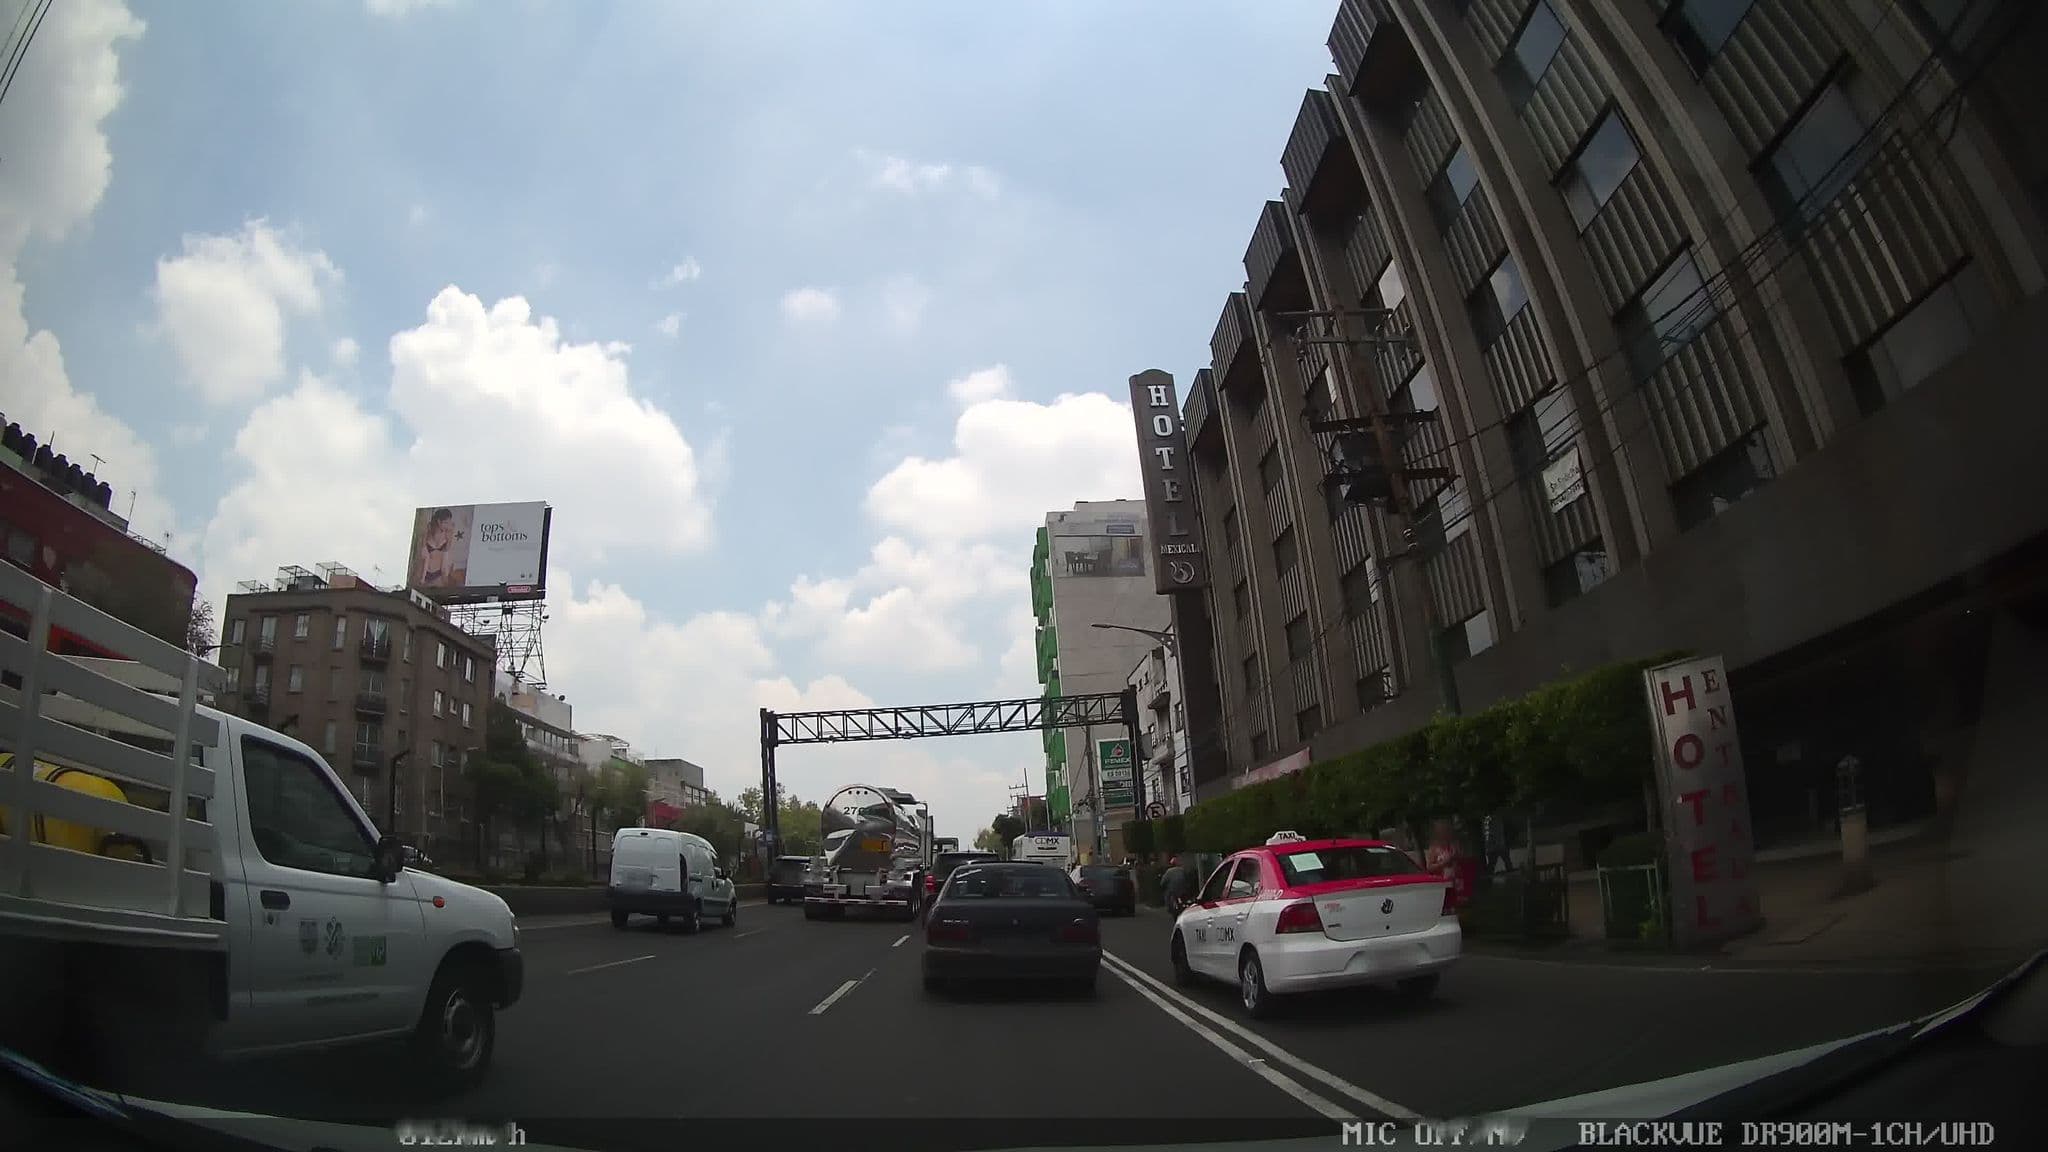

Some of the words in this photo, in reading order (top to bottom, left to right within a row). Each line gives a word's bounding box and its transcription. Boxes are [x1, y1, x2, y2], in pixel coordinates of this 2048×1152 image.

[1147, 385, 1189, 536] HOTEL
[480, 522, 505, 535] tops
[481, 531, 528, 542] bottoms
[1660, 674, 1722, 931] HOTEL
[1034, 837, 1060, 845] CDMX
[1278, 832, 1296, 841] TAXI
[1194, 927, 1207, 943] TAXI
[1216, 926, 1236, 943] CDMX
